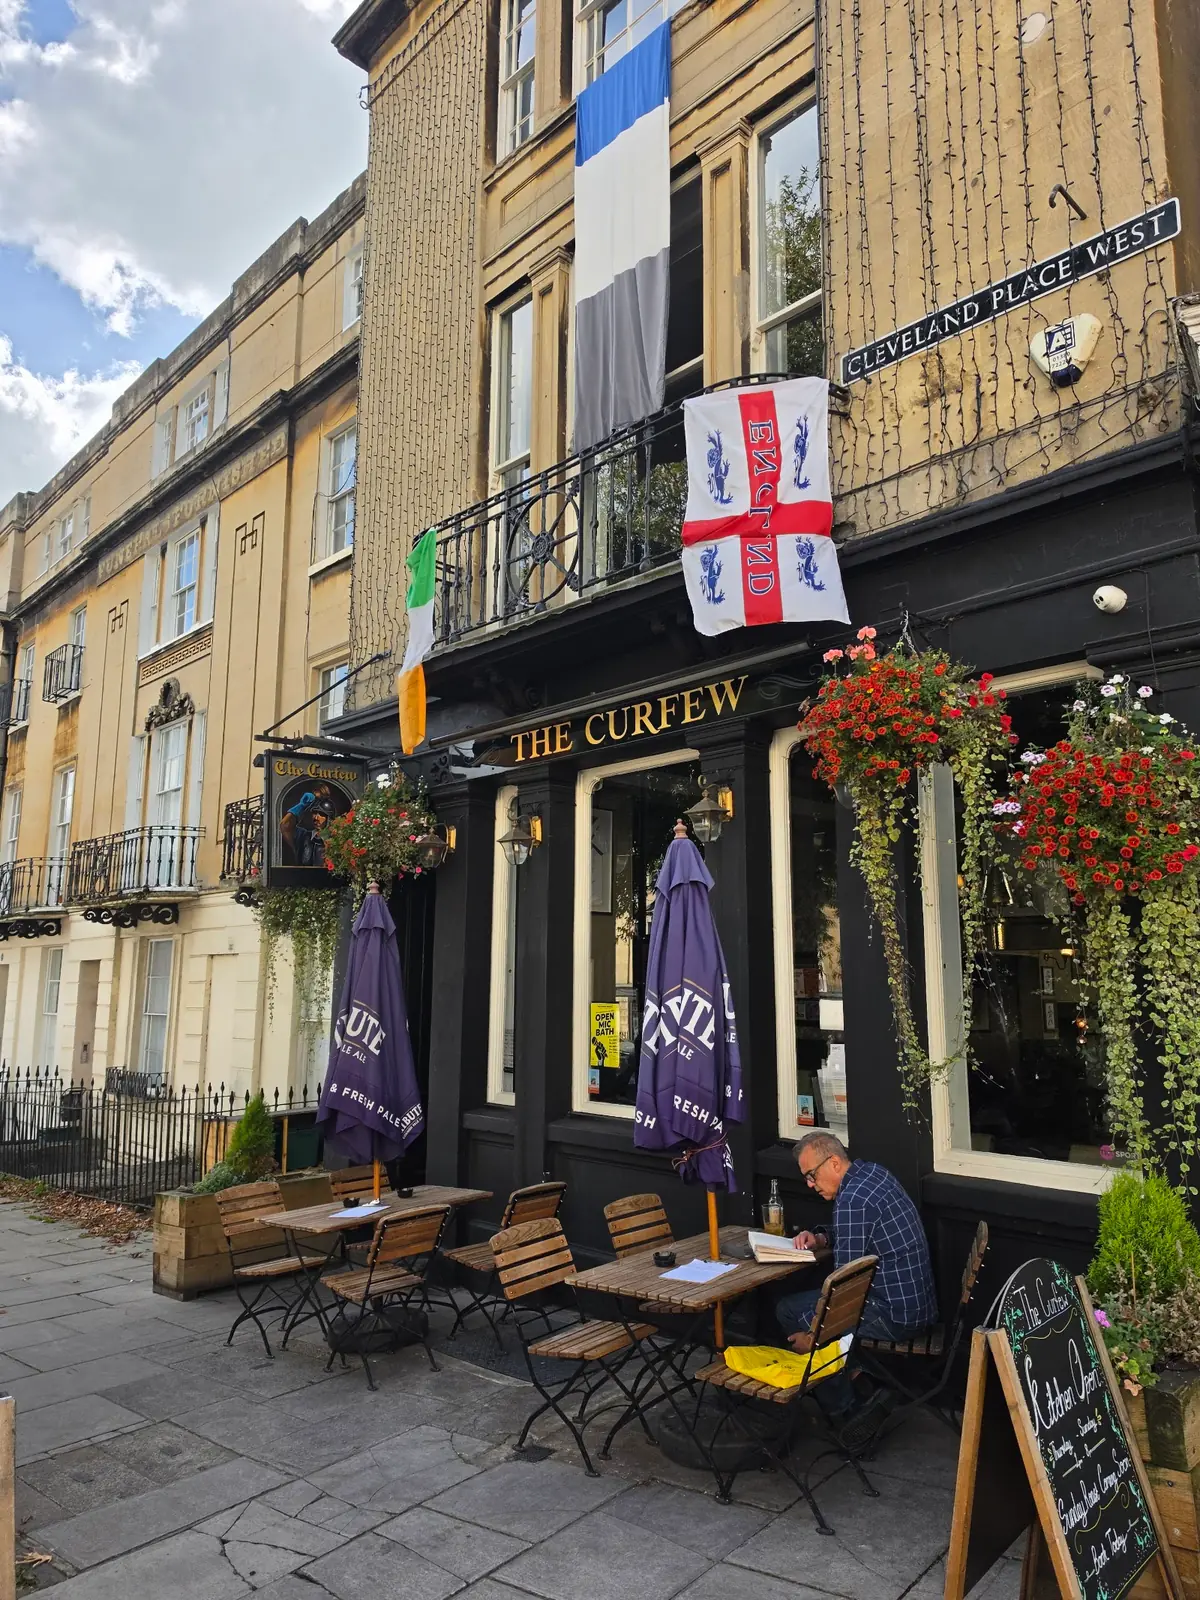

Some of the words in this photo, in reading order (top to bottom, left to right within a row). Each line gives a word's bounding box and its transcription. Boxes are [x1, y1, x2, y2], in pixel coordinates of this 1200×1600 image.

[847, 301, 979, 376] CLEVELAND
[992, 256, 1073, 309] PLACE
[1086, 211, 1167, 265] WEST
[510, 721, 573, 762] THE
[584, 675, 749, 745] CURFEW
[274, 758, 304, 777] The
[307, 762, 358, 782] Curfew
[595, 1012, 615, 1022] OPEN
[595, 1028, 614, 1037] BATH
[598, 1020, 611, 1029] MIC
[352, 1050, 367, 1064] ALE
[330, 1083, 338, 1093] &
[377, 1105, 401, 1128] PALE
[1013, 1285, 1042, 1330] The
[1036, 1277, 1069, 1318] Curfew
[1025, 1353, 1077, 1437] Kitchen
[1068, 1338, 1102, 1405] Open
[1077, 1415, 1098, 1437] Sunday
[1058, 1491, 1088, 1535] Sunday
[1080, 1480, 1100, 1510] Roast
[1112, 1448, 1132, 1478] Soon
[1090, 1542, 1110, 1575] Book
[1104, 1527, 1128, 1555] Today
